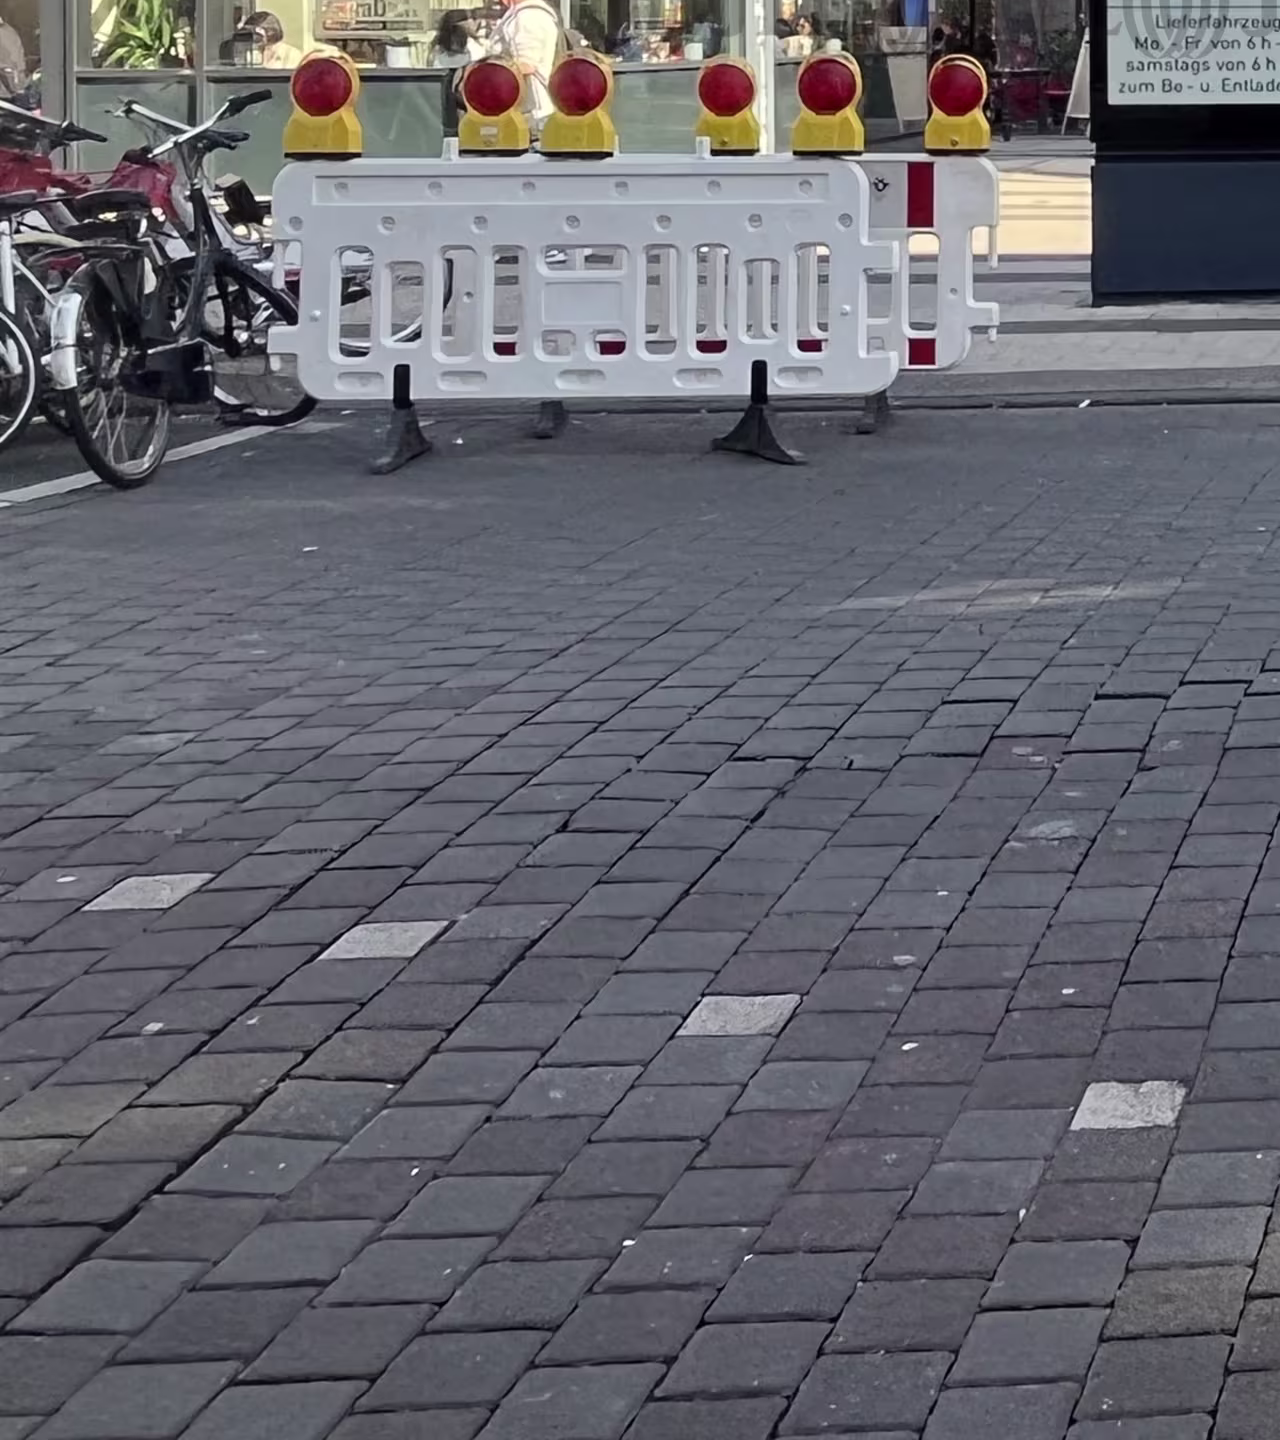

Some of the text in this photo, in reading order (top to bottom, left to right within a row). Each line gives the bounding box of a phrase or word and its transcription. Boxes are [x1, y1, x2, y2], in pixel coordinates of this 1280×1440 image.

[1210, 39, 1241, 50] von
[1126, 58, 1211, 76] samstags
[1216, 60, 1246, 71] von
[1118, 81, 1154, 93] zum
